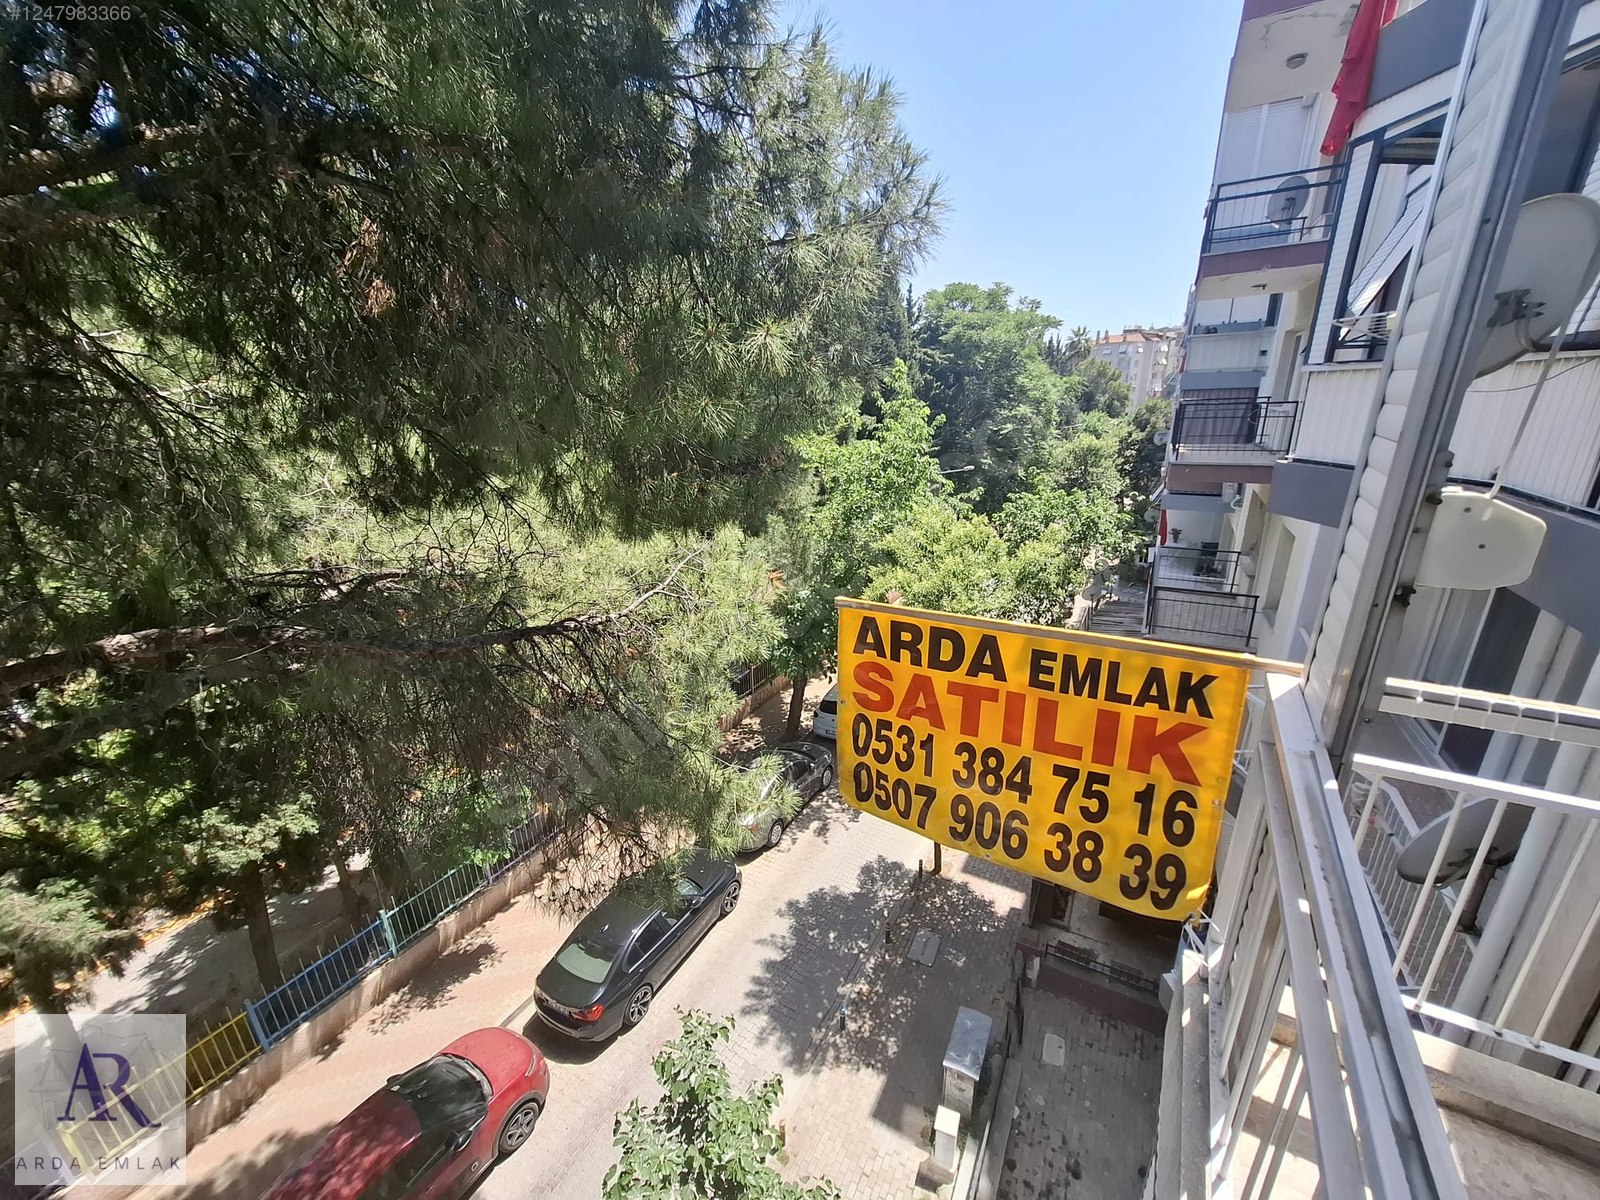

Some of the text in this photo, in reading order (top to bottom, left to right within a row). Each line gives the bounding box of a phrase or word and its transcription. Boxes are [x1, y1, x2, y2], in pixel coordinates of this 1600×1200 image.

[852, 616, 1219, 718] ARDA EMLAK
[852, 661, 1208, 787] SATILIK
[852, 713, 1199, 848] 0531 384 75 16
[853, 762, 1187, 911] 0507 906 38 39
